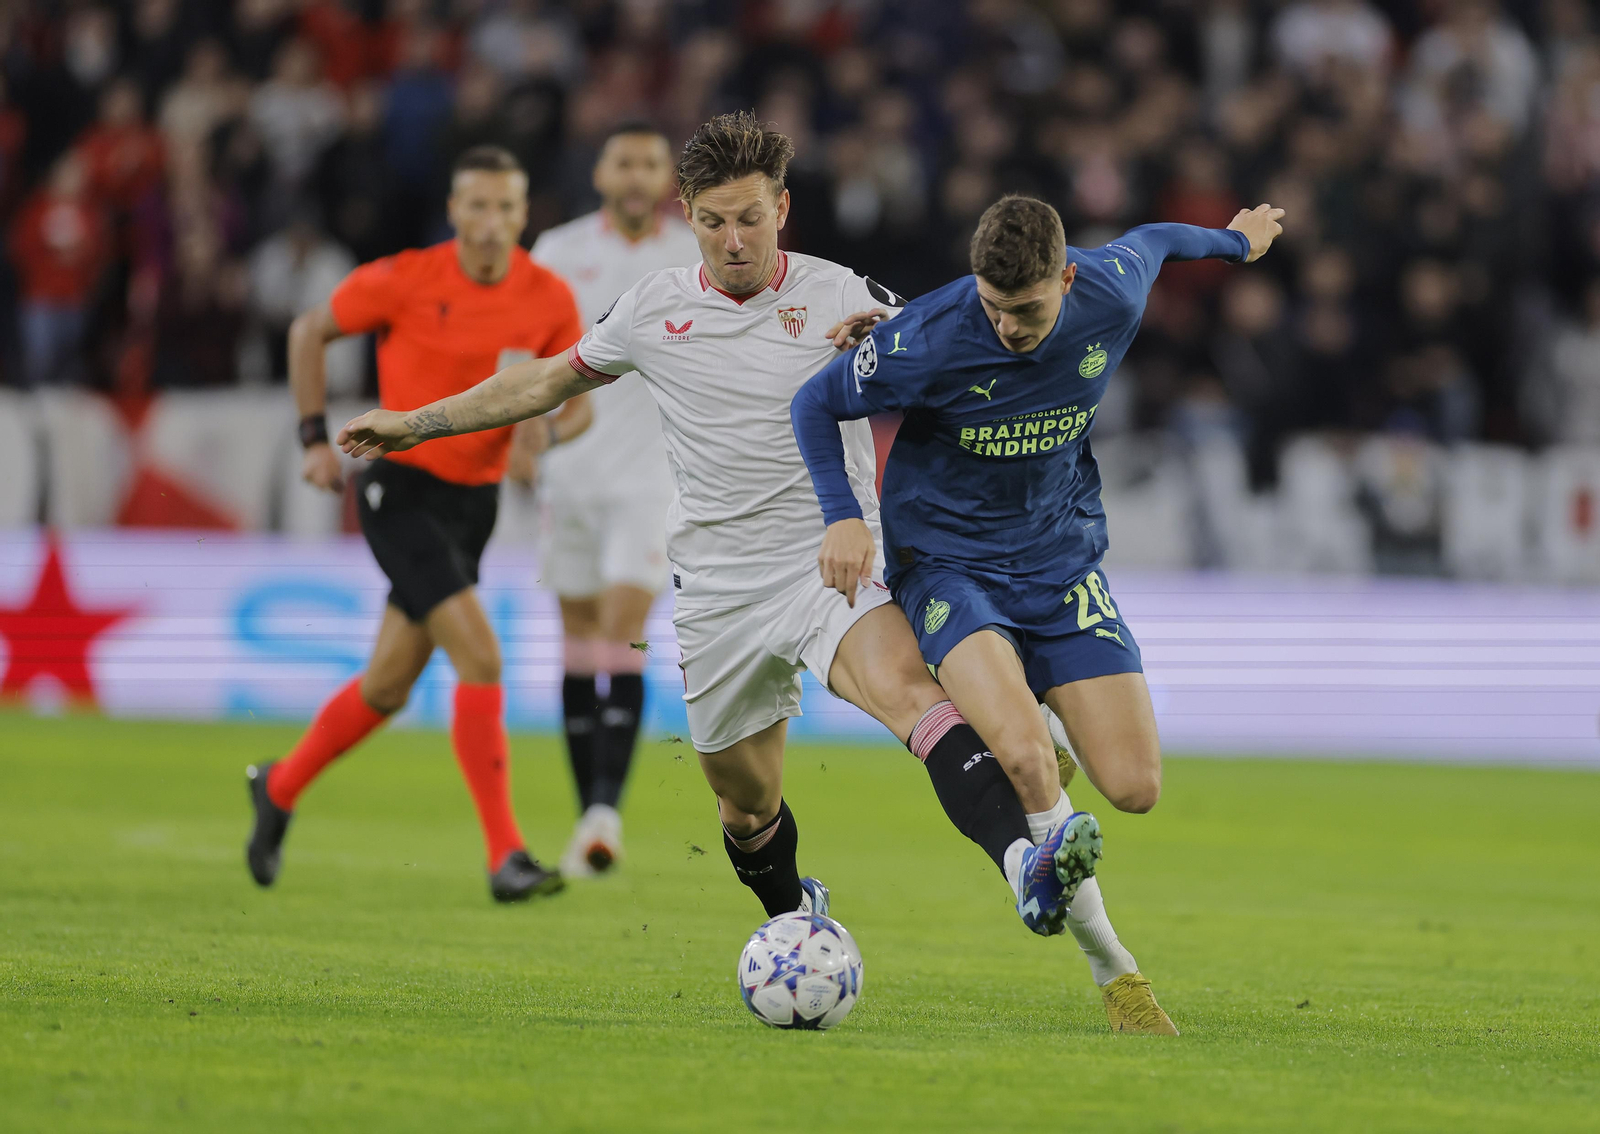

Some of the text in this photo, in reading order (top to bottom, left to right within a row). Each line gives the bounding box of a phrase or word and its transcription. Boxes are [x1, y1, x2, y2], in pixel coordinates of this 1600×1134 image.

[960, 403, 1099, 441] BRAINPORT
[993, 405, 1078, 422] METROPOOLREGIO
[958, 421, 1087, 456] EINDHOVE
[1063, 570, 1118, 630] 20
